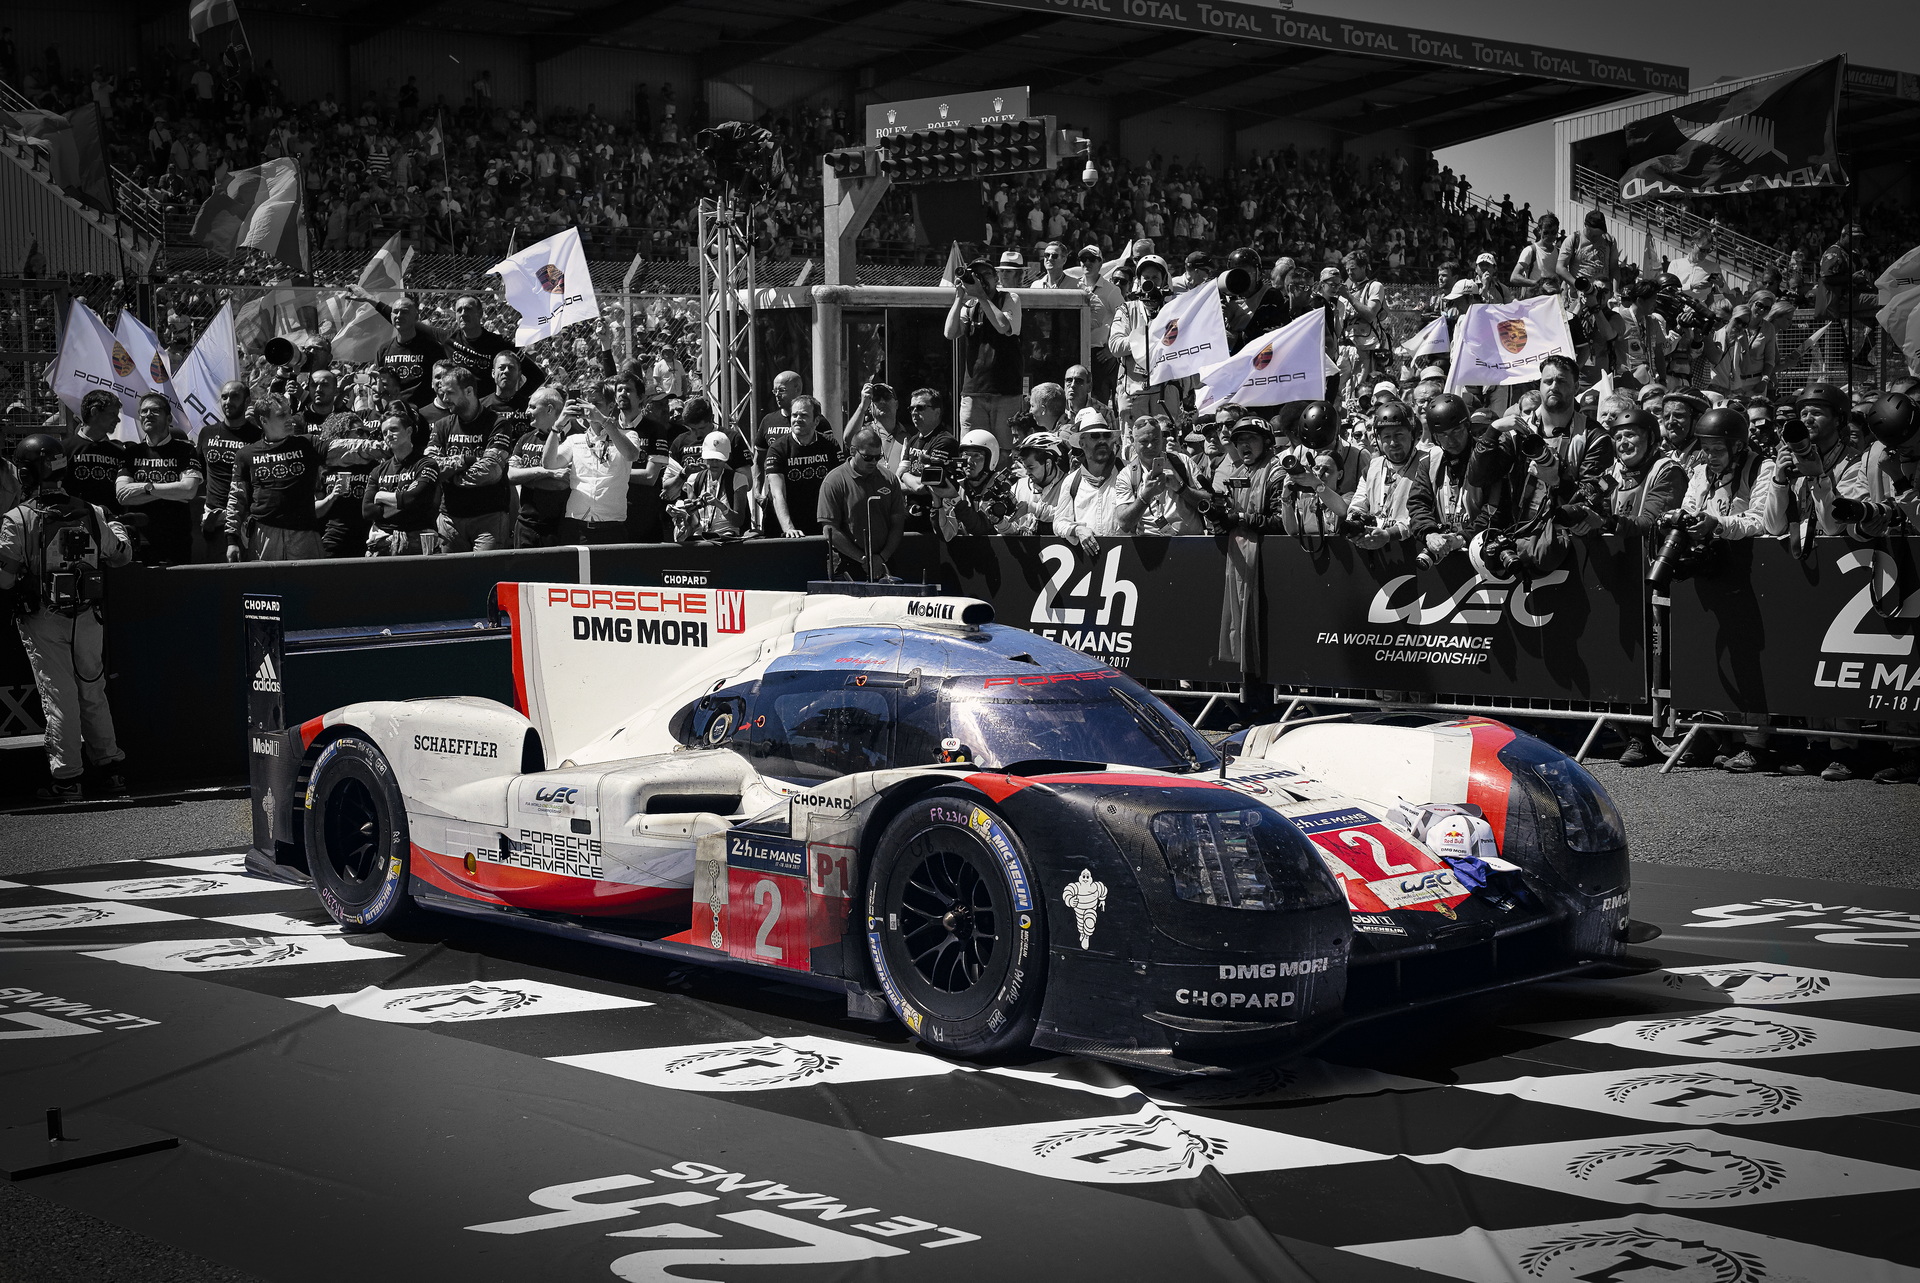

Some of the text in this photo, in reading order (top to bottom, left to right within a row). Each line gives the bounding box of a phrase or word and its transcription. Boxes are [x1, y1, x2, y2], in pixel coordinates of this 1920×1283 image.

[1197, 3, 1261, 32] TOTAL
[1271, 14, 1332, 43] TOTAL
[1341, 24, 1398, 51] TOTAL
[1408, 34, 1463, 59] TOTAL
[1472, 43, 1524, 68] TOTAL
[1531, 51, 1580, 75] TOTAL
[1588, 59, 1636, 83] TOTAL
[1643, 67, 1686, 90] TOTAL
[1845, 70, 1896, 88] MICHELIN
[385, 354, 424, 363] HATTRICK!
[134, 458, 178, 467] HATTRICK!
[253, 450, 304, 464] HATTRICK!
[787, 454, 829, 466] HATTRICK!
[663, 575, 708, 585] CHOPARD
[1030, 544, 1138, 626] 24h
[244, 600, 280, 611] CHOPARD
[548, 588, 707, 614] PORSCHE
[1368, 570, 1569, 627] WEC
[717, 590, 744, 631] HY
[907, 600, 941, 618] Mobil
[573, 616, 708, 648] DMG MORI
[1061, 630, 1133, 653] MANS
[1316, 633, 1493, 649] FIA WORLD ENDURANCE
[1109, 656, 1130, 667] 2017
[1375, 650, 1487, 665] CHAMPIONSHIP
[1814, 661, 1864, 688] LE
[253, 678, 281, 692] adidas
[1868, 694, 1908, 711] 17-18
[253, 738, 273, 756] Mobil
[414, 735, 498, 758] SCHAEFFLER
[536, 787, 578, 804] WEC
[794, 794, 852, 810] CHOPARD
[930, 807, 943, 822] FR
[1314, 818, 1331, 827] LE
[1330, 812, 1367, 824] MANS
[520, 829, 602, 853] PORSCHE
[732, 837, 802, 864] 24h LE MANS
[1339, 830, 1417, 876] 2
[817, 852, 849, 891] P1
[992, 834, 1028, 907] MICHELIN
[1401, 872, 1452, 893] WEC
[364, 883, 393, 921] MICHELIN
[754, 879, 783, 960] 2
[1363, 925, 1404, 934] MICHELIN
[870, 936, 900, 1007] MICHELIN
[1219, 957, 1328, 980] DMG MORI
[1175, 988, 1295, 1008] CHOPARD
[81, 1013, 162, 1030] LE
[651, 1160, 982, 1249] LE MANS
